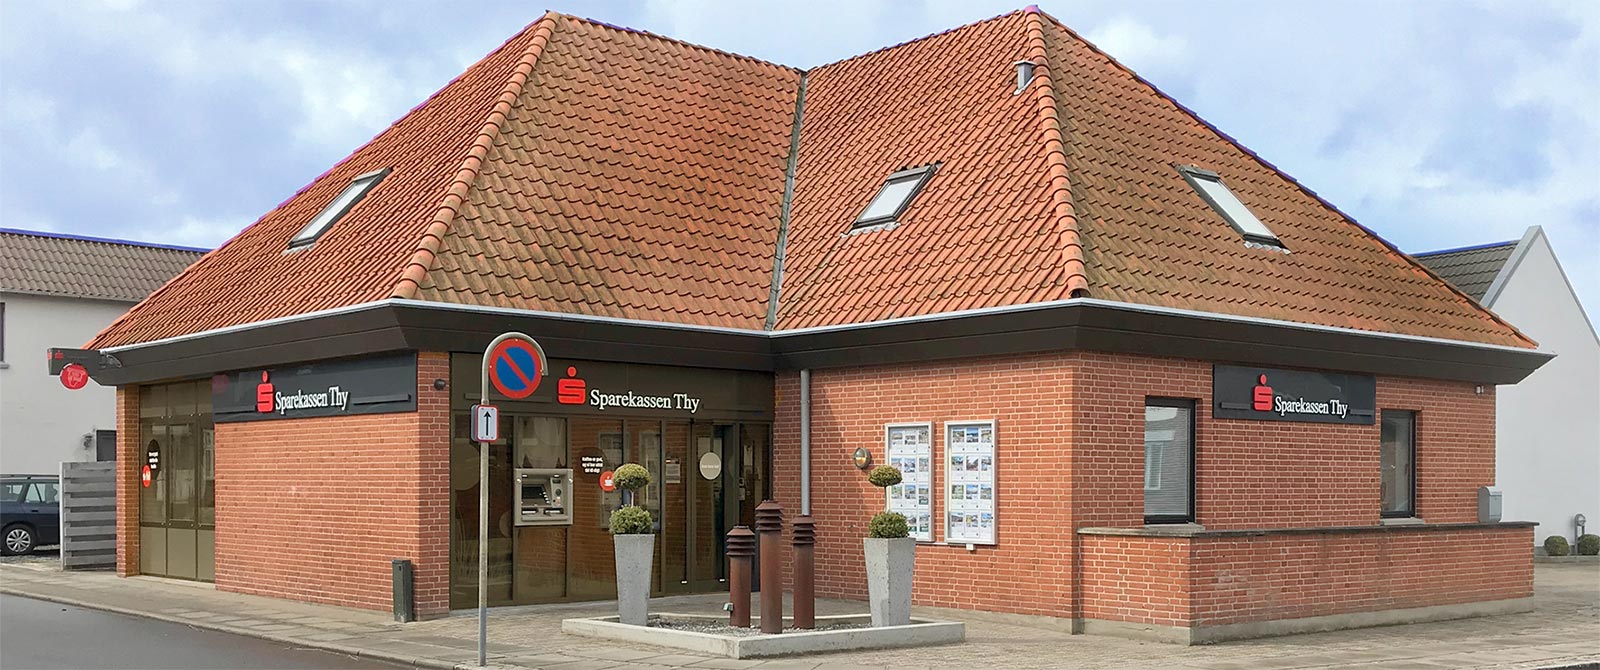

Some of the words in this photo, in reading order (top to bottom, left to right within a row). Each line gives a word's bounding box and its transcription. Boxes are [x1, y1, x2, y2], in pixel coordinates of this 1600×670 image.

[275, 389, 328, 415] Sparekassen
[328, 386, 348, 411] Thy
[590, 389, 672, 410] Sparekassen
[673, 393, 700, 413] Thy
[1275, 396, 1329, 416] Sparekassen
[1330, 399, 1348, 419] Thy
